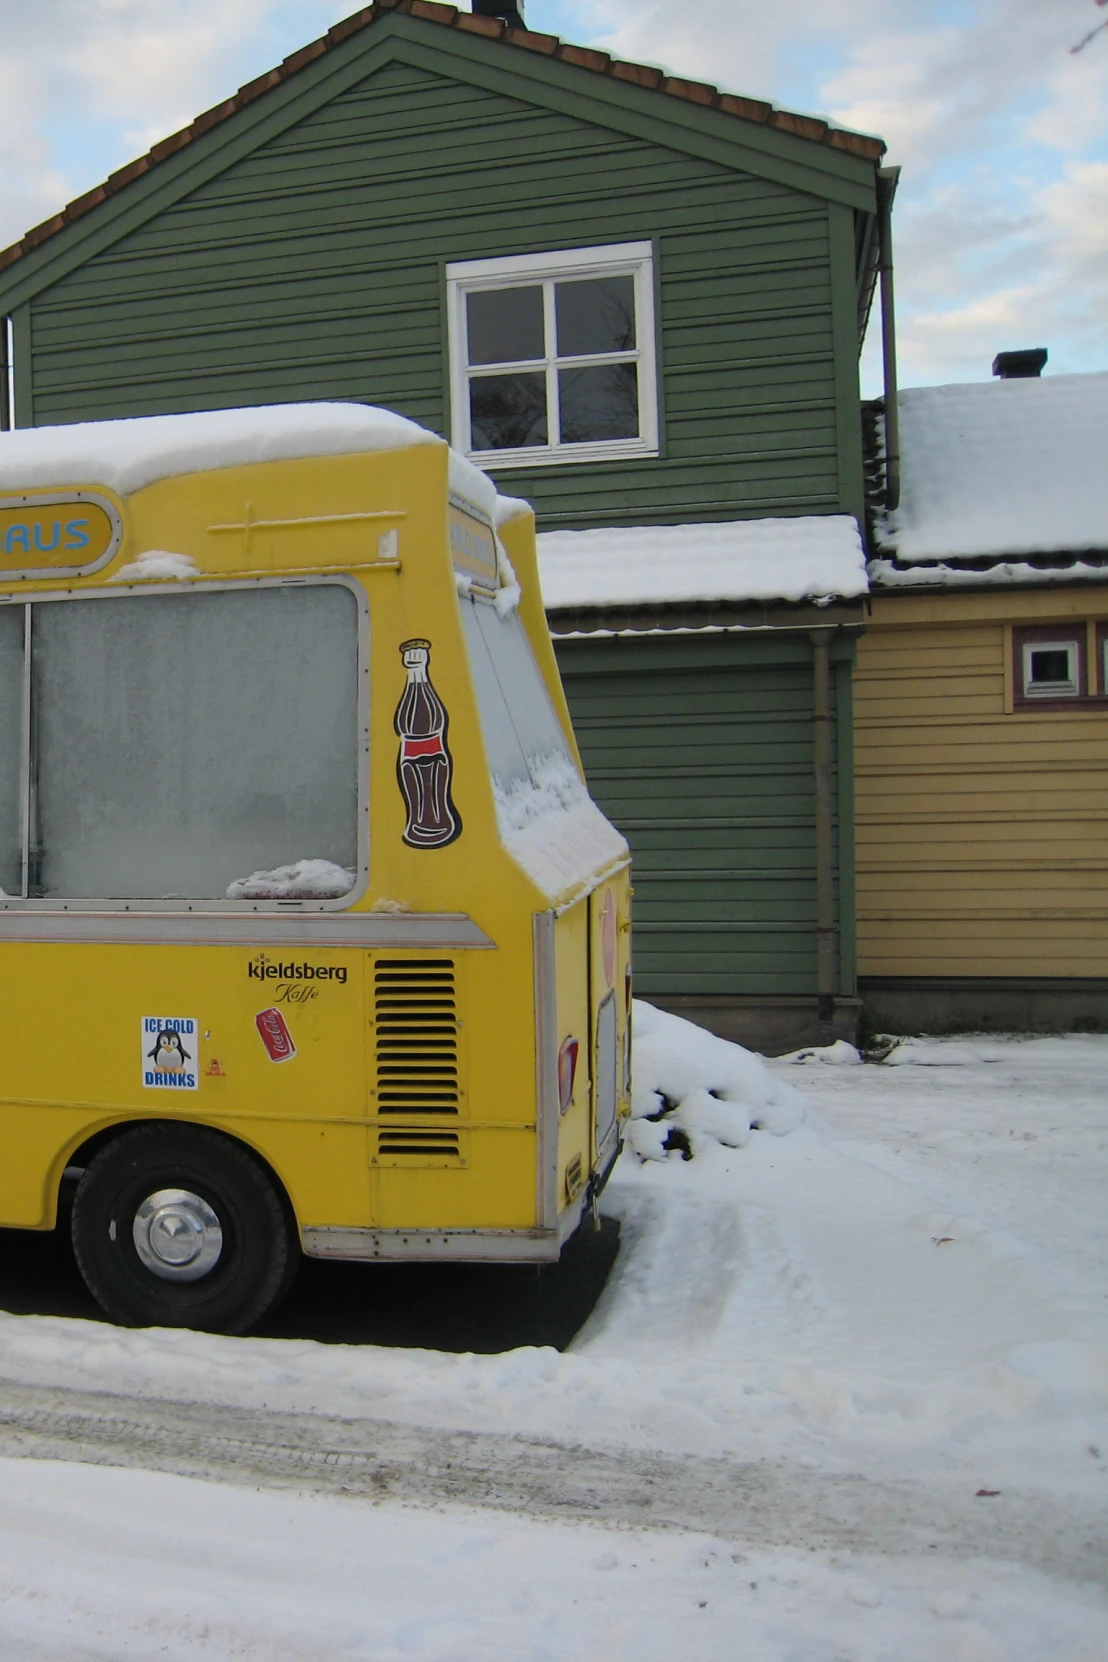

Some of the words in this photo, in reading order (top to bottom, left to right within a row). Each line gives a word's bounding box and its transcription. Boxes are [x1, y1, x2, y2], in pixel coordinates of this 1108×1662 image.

[248, 960, 348, 984] kjeldsberg
[273, 983, 319, 1003] Kaffe
[145, 1018, 163, 1033] ICE
[165, 1019, 194, 1034] COLD
[145, 1071, 195, 1087] DRINKS
